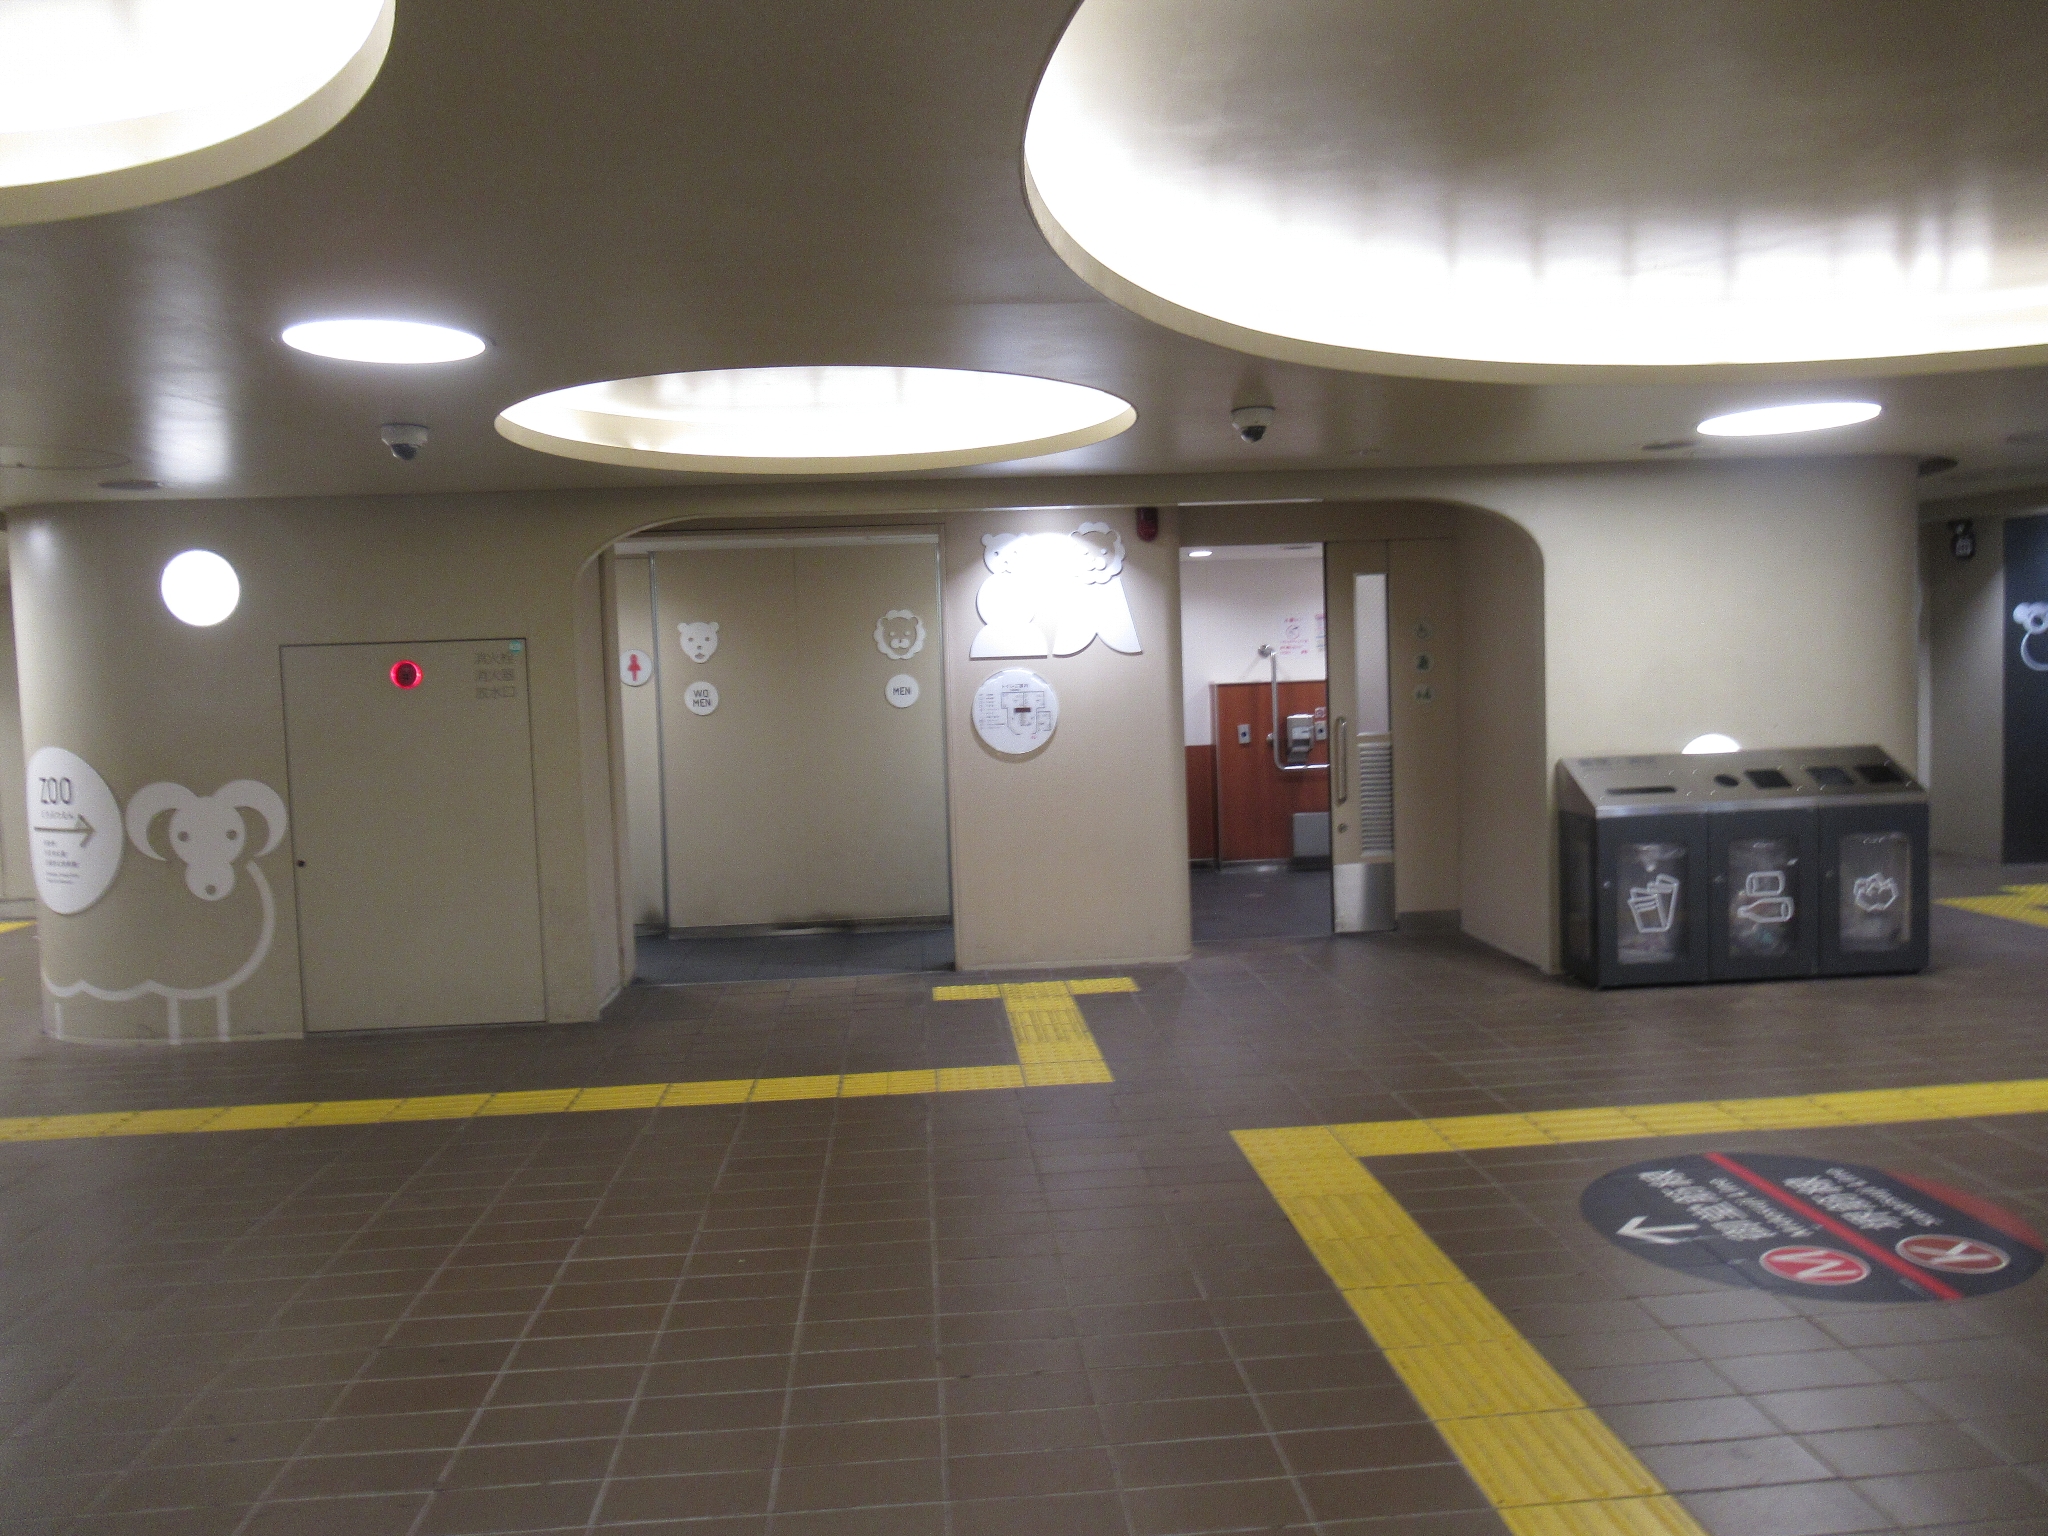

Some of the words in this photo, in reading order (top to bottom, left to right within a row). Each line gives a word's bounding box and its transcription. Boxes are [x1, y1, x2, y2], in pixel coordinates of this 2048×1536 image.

[474, 668, 515, 682] 消火器
[693, 689, 709, 698] WO
[893, 687, 911, 696] MEN
[692, 698, 711, 707] MEN
[39, 776, 72, 805] ZOO
[1638, 1168, 1777, 1242] 御堂筋線
